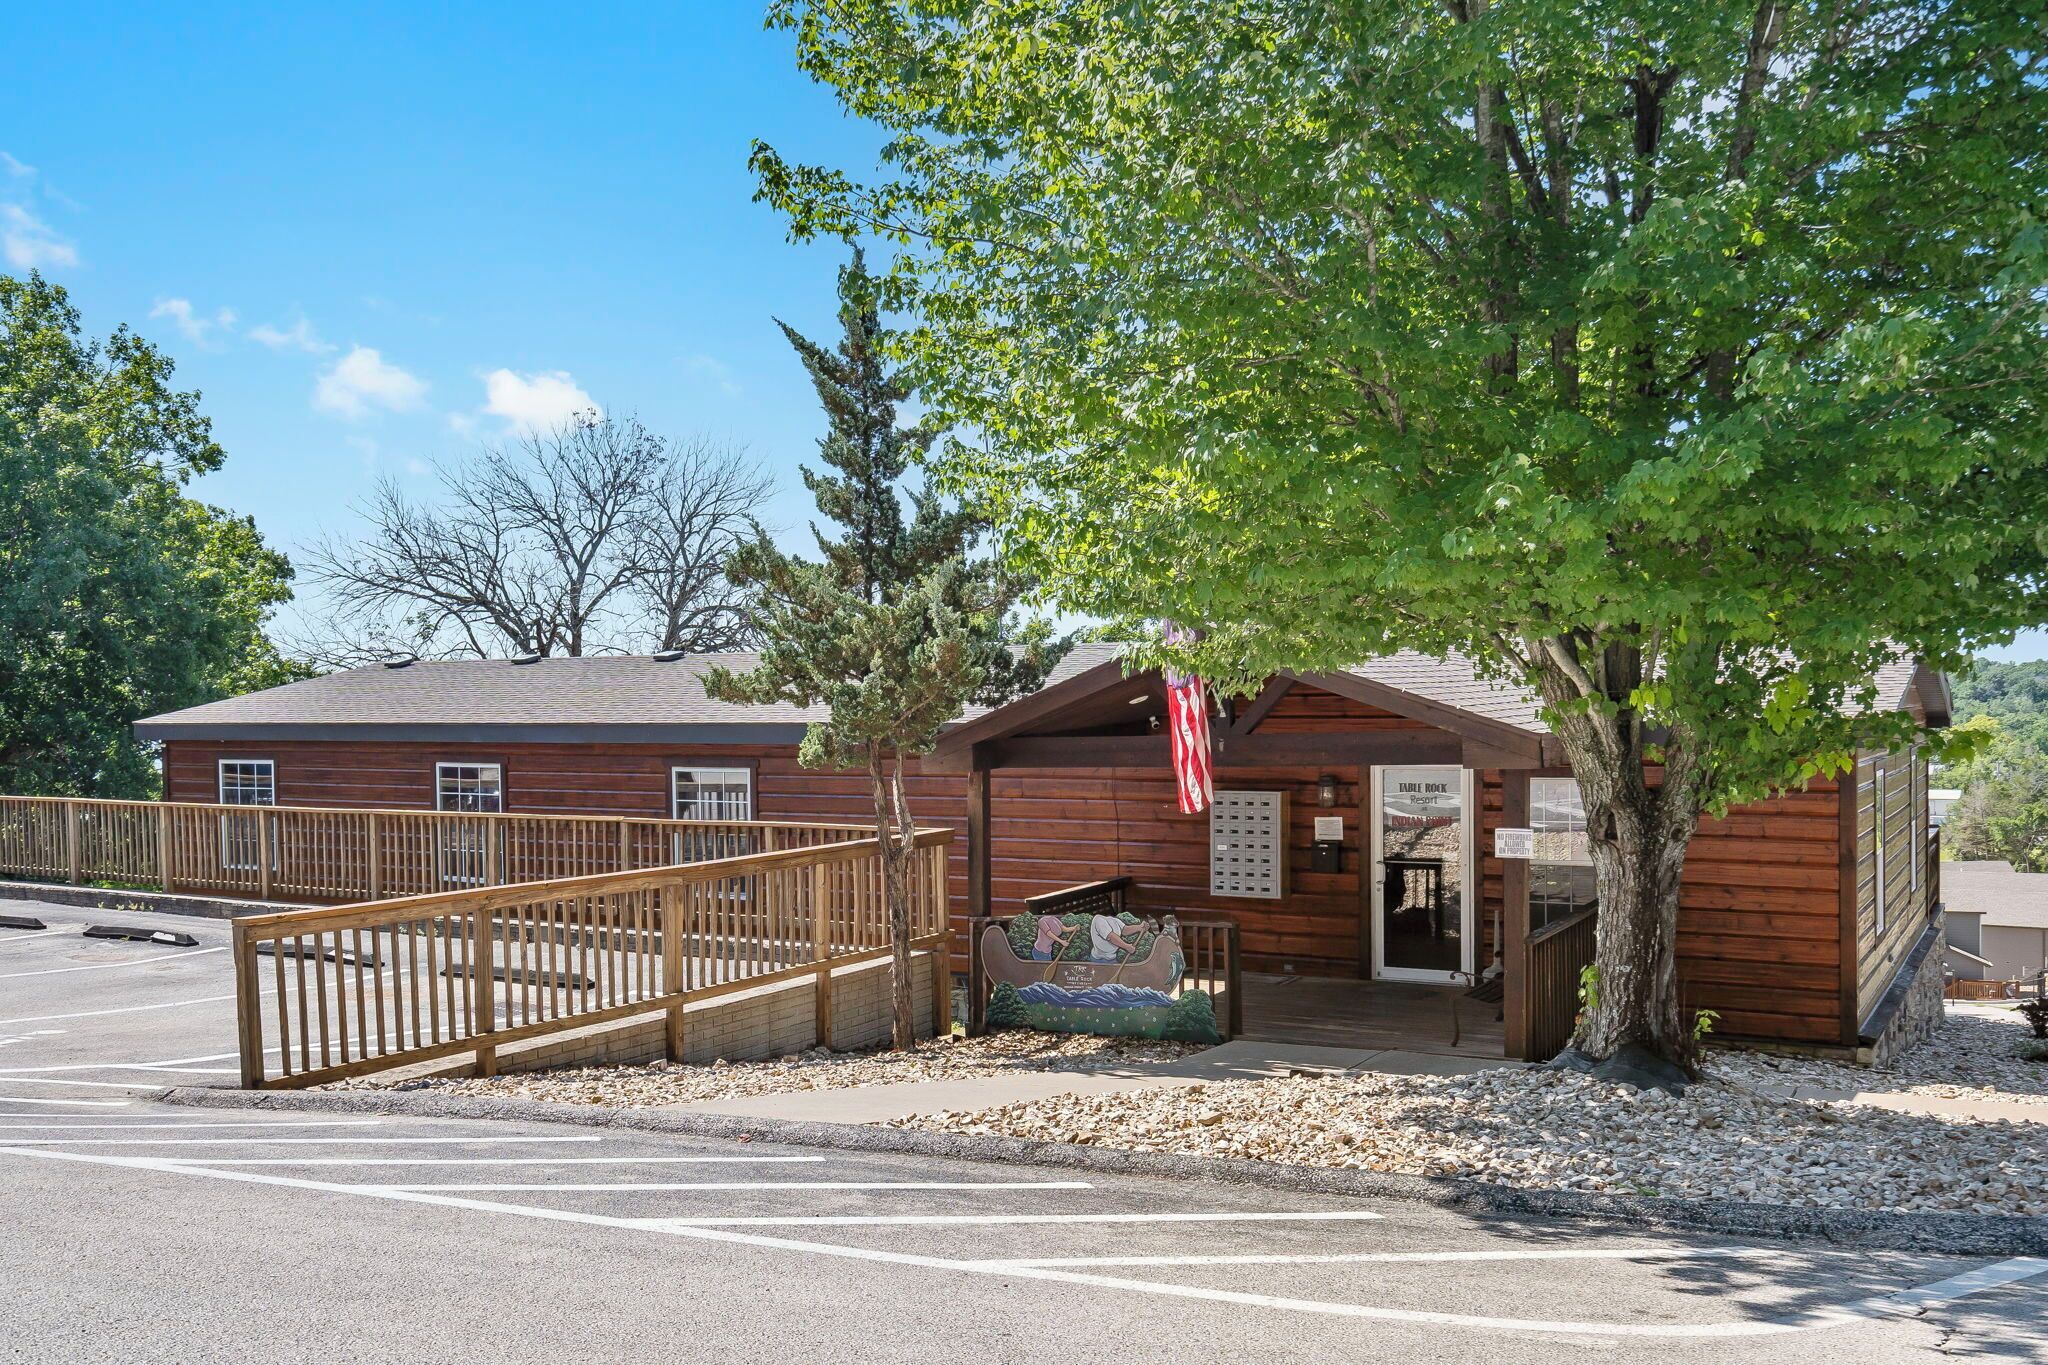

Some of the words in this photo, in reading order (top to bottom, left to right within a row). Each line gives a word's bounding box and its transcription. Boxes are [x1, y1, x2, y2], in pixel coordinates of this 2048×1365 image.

[1398, 782, 1422, 793] TABLE
[1425, 783, 1447, 793] ROCK
[1410, 794, 1438, 804] Resort
[1505, 833, 1532, 841] FIREWORKS
[1504, 840, 1525, 848] ALLOWED
